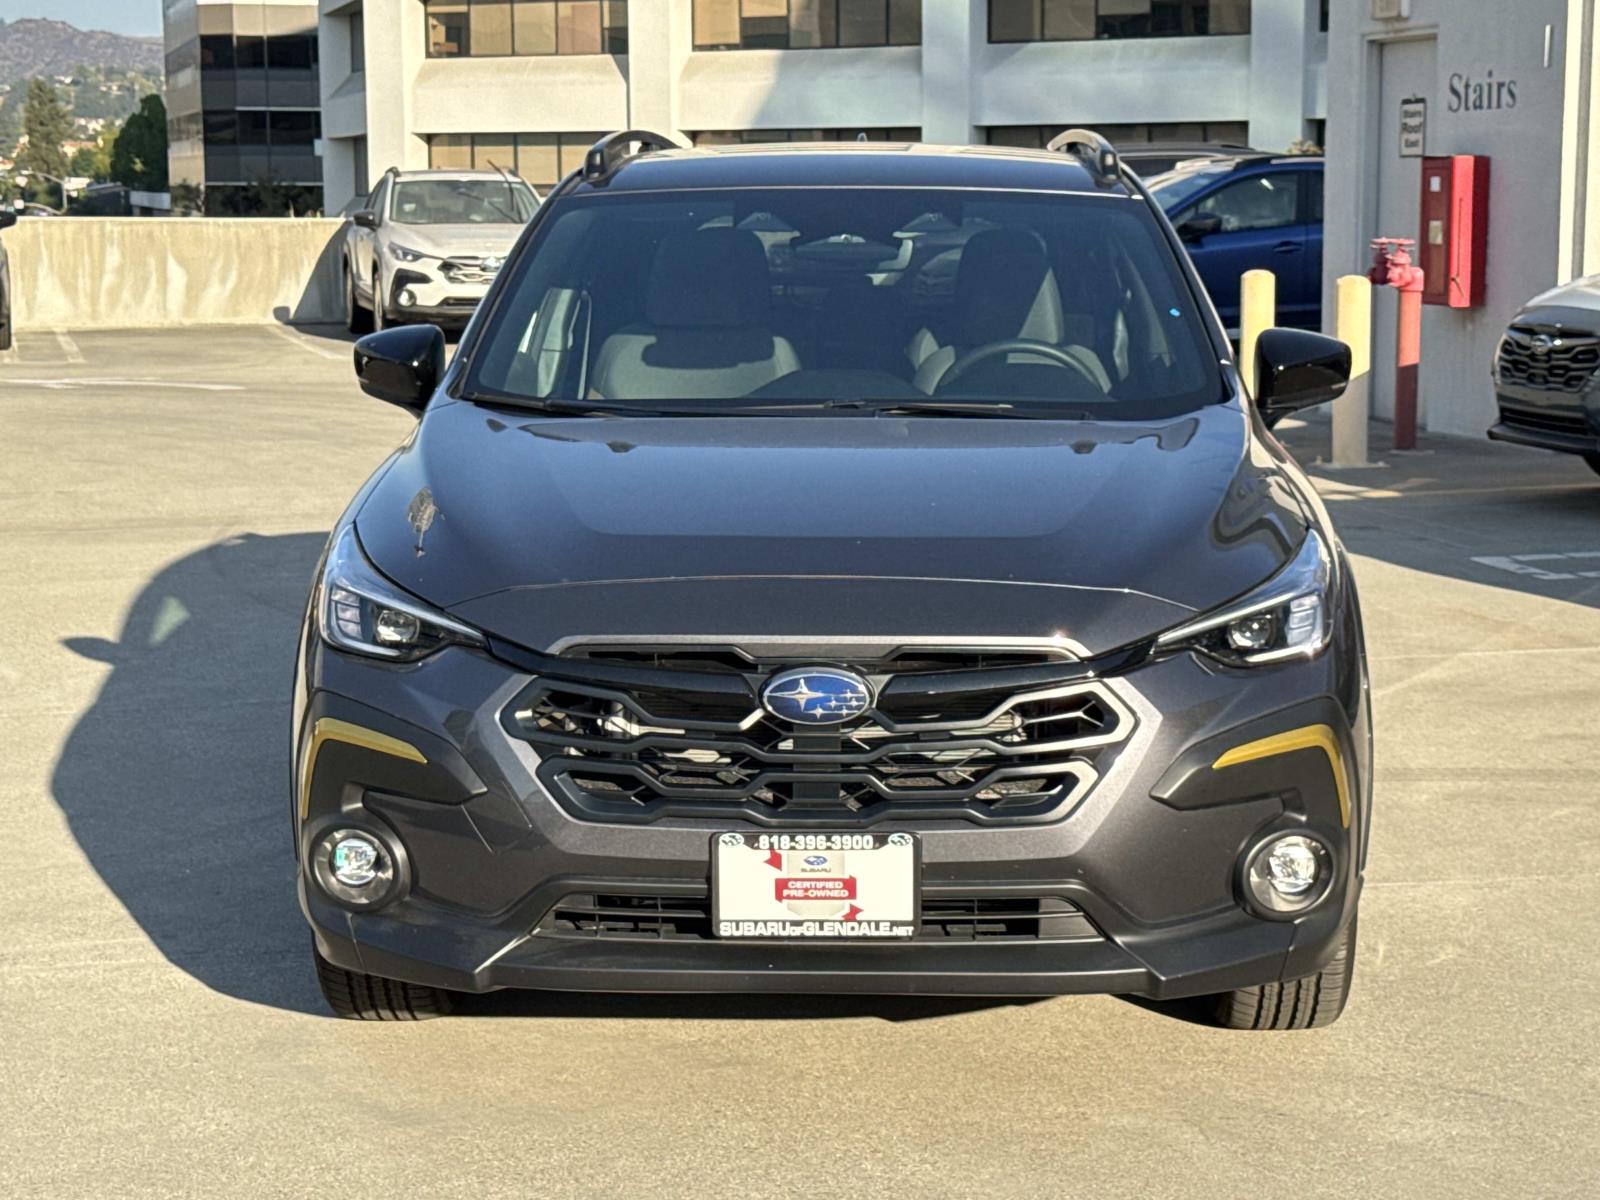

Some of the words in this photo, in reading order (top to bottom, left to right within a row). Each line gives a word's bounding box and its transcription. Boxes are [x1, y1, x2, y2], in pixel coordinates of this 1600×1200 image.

[1448, 70, 1517, 112] Stairs
[759, 834, 873, 850] 818-396-3900
[788, 880, 843, 889] CERTIFIED
[782, 889, 849, 898] PRE-OWNED
